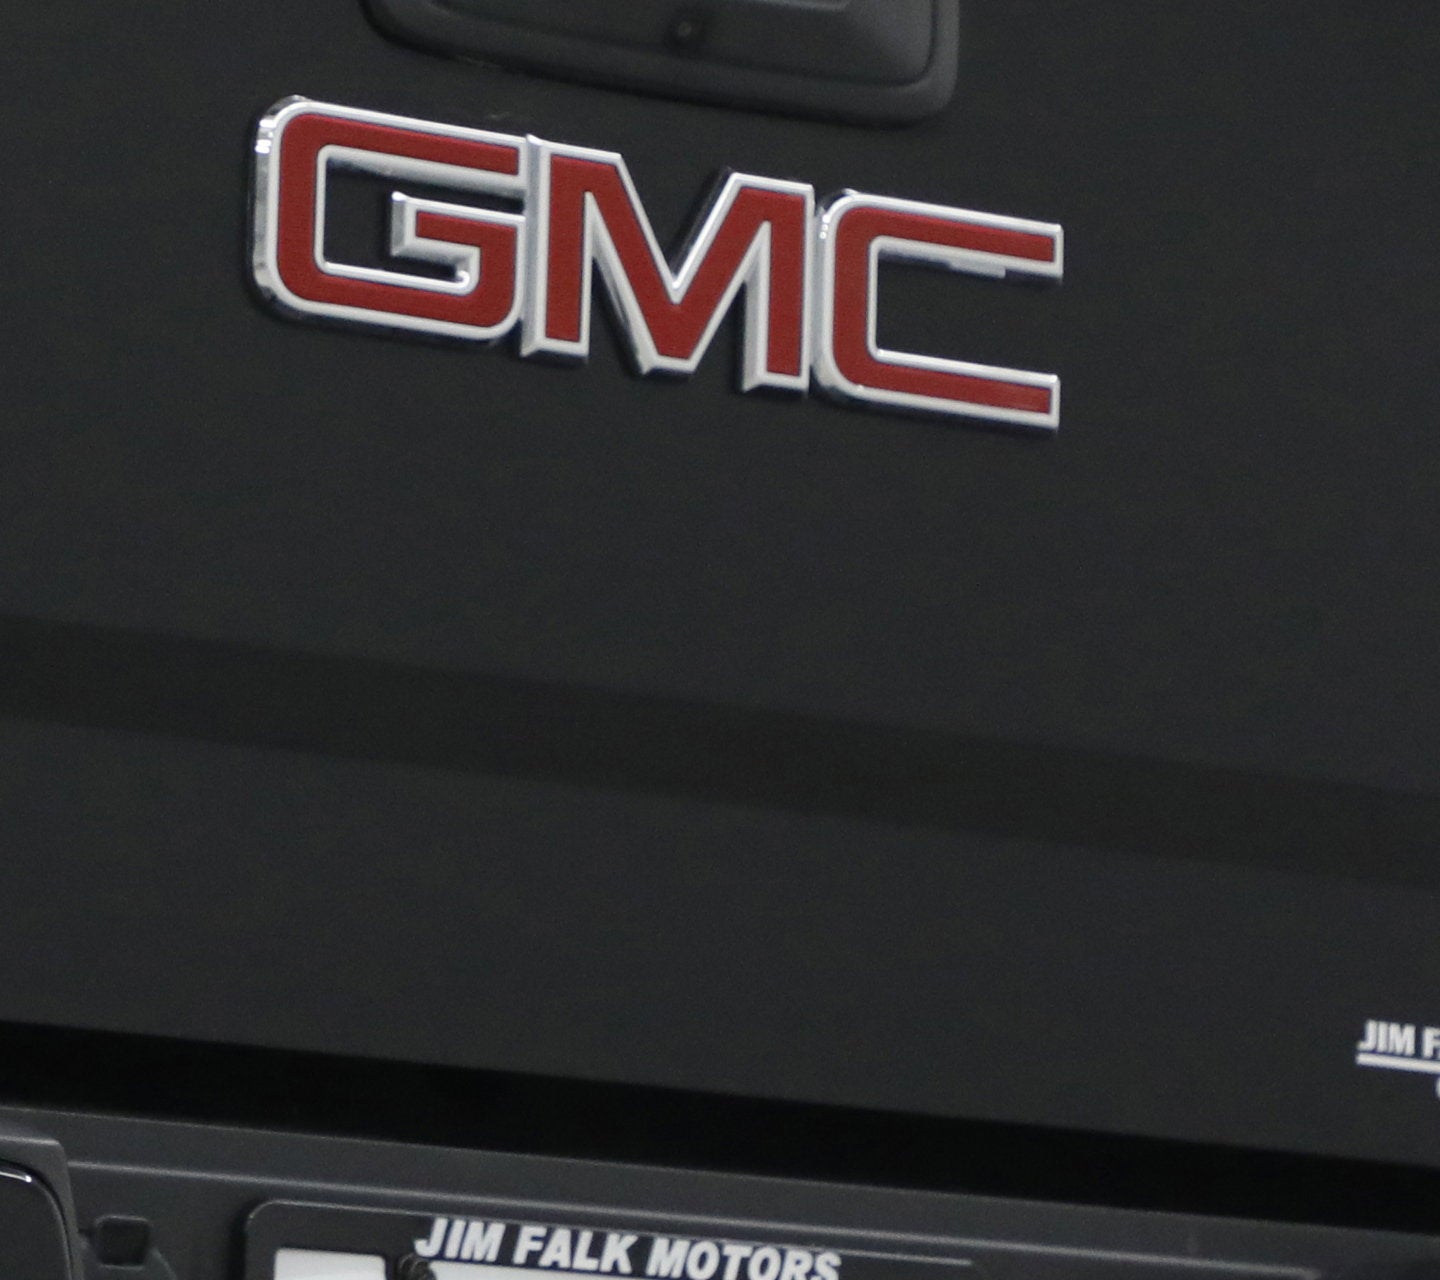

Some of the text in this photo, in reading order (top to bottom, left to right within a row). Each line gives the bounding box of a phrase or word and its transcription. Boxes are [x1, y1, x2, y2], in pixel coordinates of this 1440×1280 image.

[252, 95, 1064, 430] GMC
[1357, 1019, 1416, 1057] JIM
[414, 1216, 506, 1263] JIM
[513, 1224, 638, 1276] FALK
